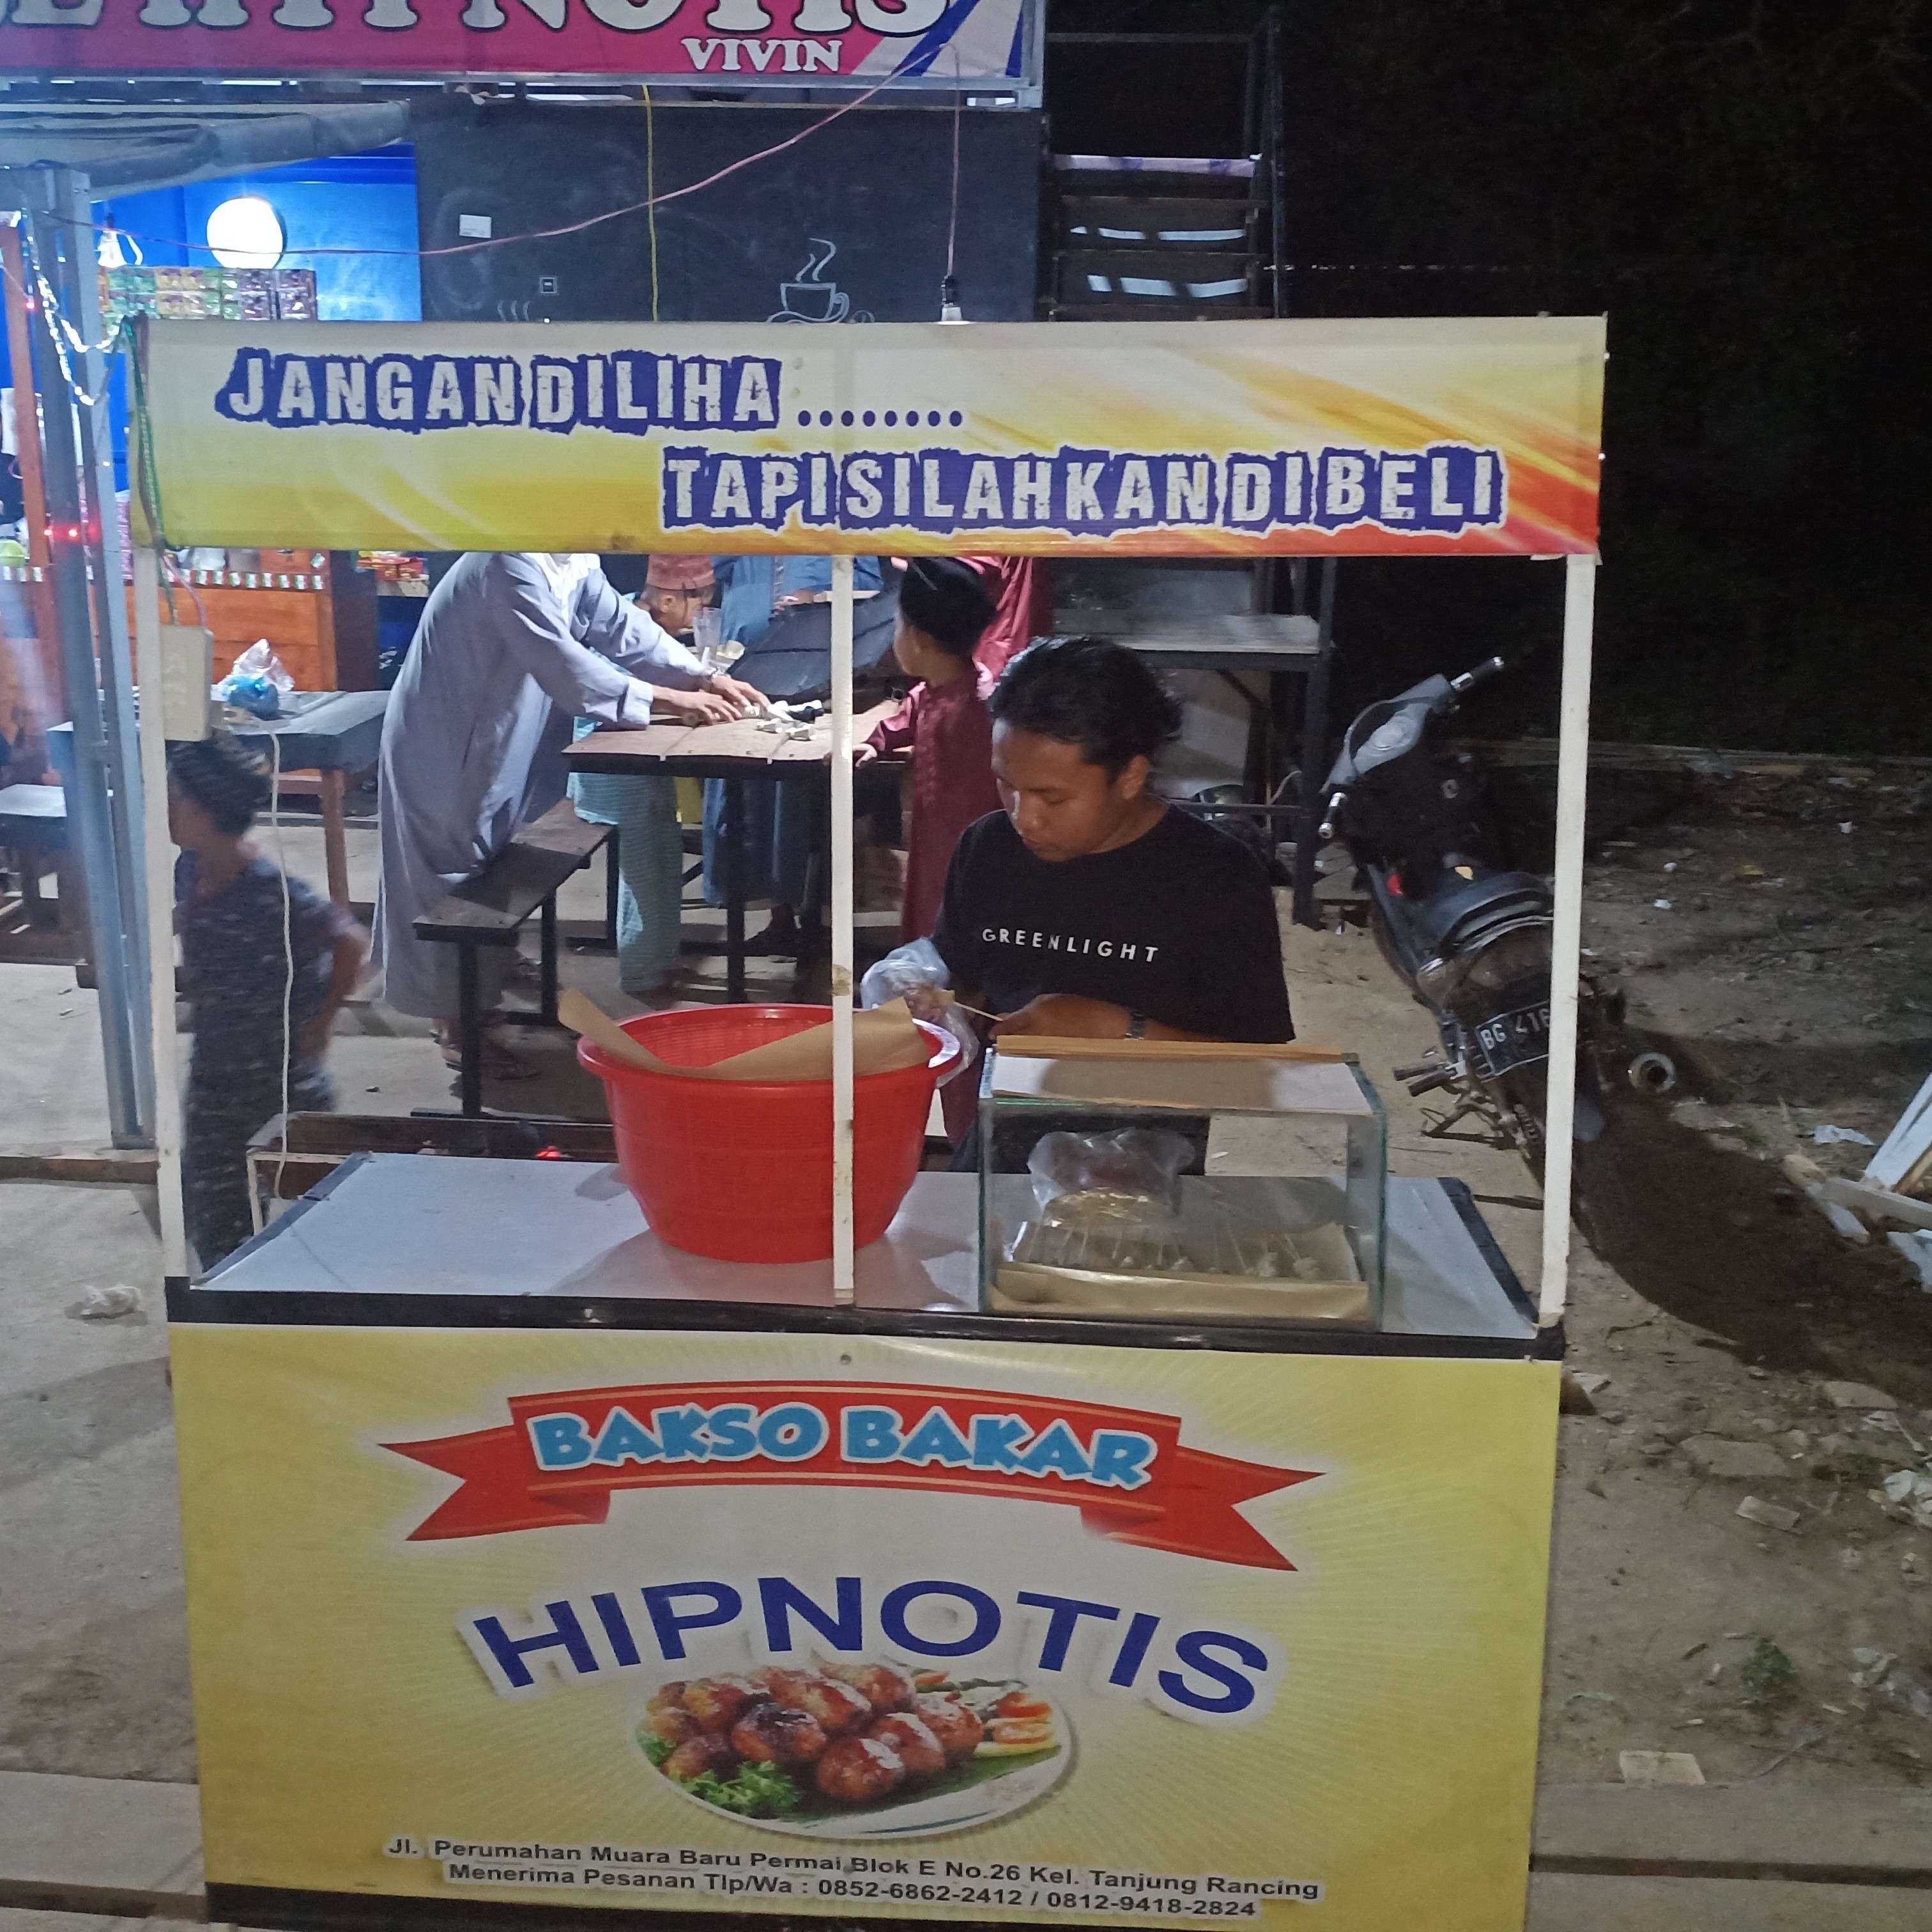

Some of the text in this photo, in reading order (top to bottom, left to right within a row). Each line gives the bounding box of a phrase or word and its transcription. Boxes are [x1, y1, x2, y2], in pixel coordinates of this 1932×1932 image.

[682, 38, 843, 72] VIVIN
[215, 347, 524, 433] JANGAN
[662, 446, 838, 530] TAPI
[839, 445, 1218, 537] SILAHKAN
[981, 928, 1159, 963] GREENLIGHT
[1480, 1023, 1506, 1050] BG
[529, 1402, 1159, 1491] BAKSO BAKAR
[472, 1577, 1269, 1715] HIPNOTIS
[389, 1838, 1319, 1900] Jl. Perumahan Muara Baru Permai Blok E No.26 Kel. Tanjung Rancing
[449, 1863, 575, 1884] Menerima
[584, 1868, 695, 1889] Pesanan
[703, 1873, 792, 1895] Tlp/Wa
[818, 1879, 1022, 1906] 0852-6862-2412
[1047, 1892, 1256, 1916] 0812-9418-2824
